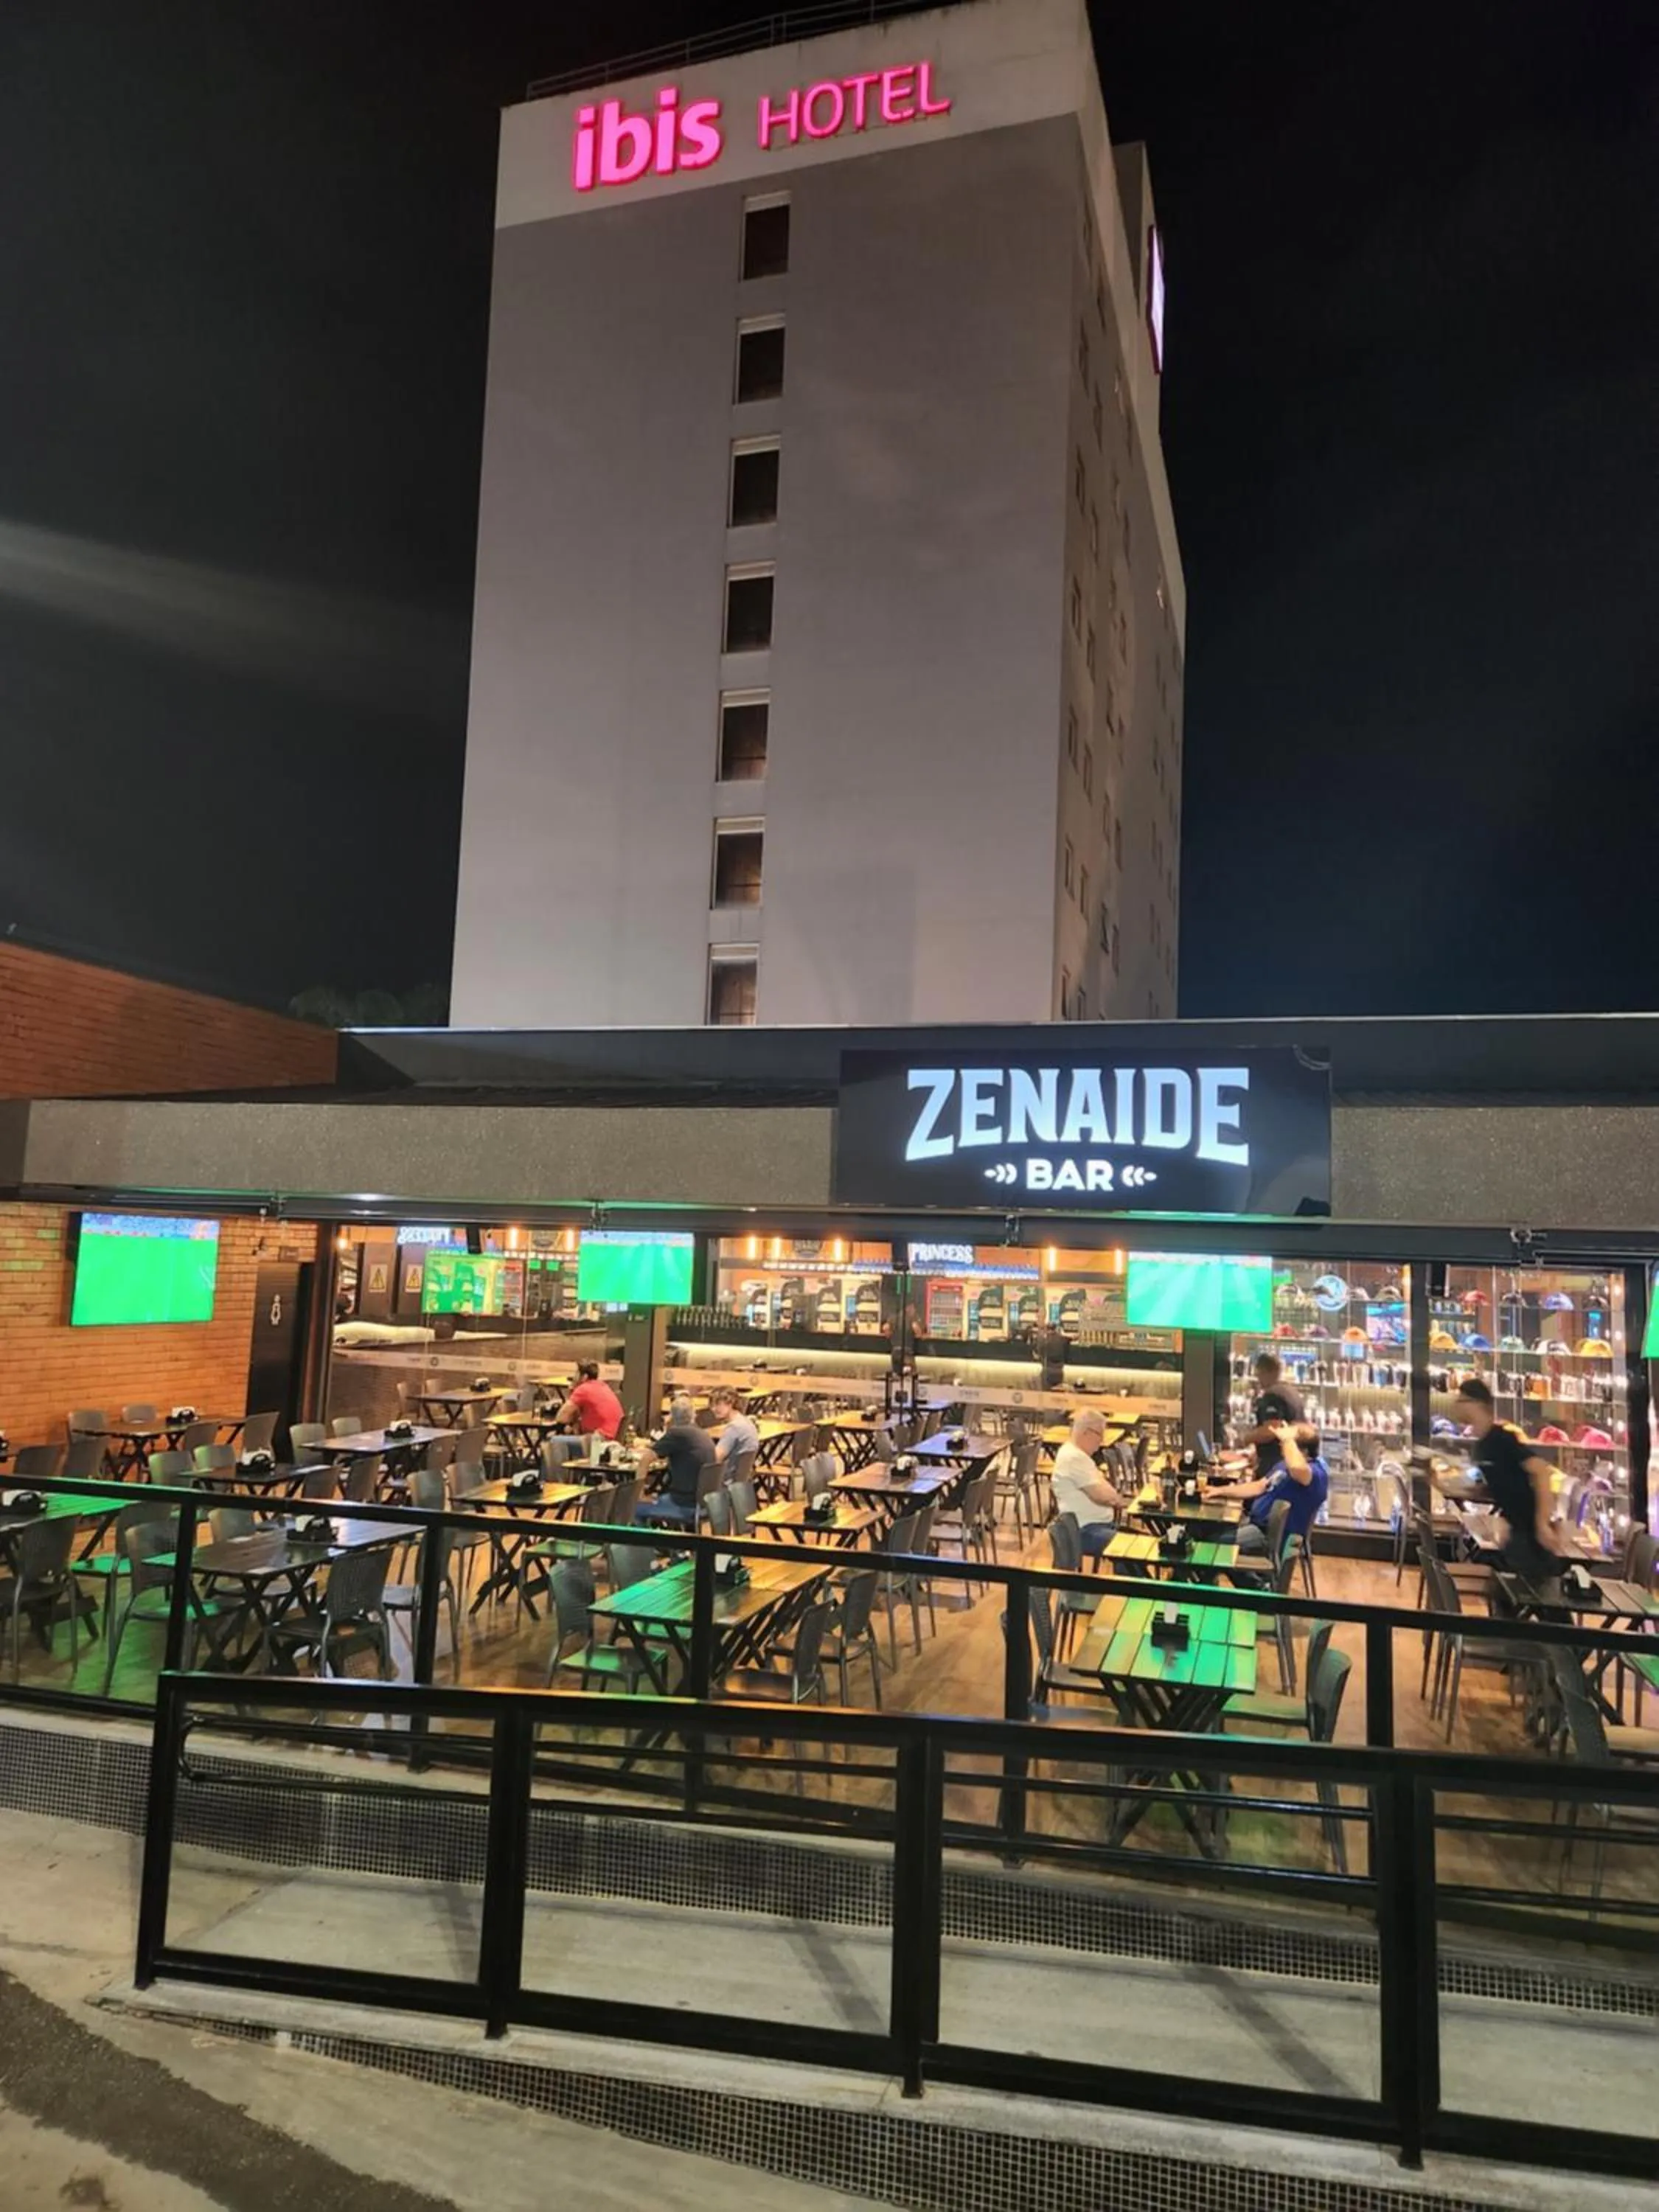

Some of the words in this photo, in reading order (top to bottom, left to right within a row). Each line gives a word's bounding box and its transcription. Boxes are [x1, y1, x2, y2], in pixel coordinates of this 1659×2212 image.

[574, 87, 721, 191] ibis
[758, 61, 951, 149] HOTEL
[905, 1068, 1250, 1166] ZENAIDE
[1026, 1158, 1114, 1191] BAR
[908, 1242, 973, 1264] PRINCESS
